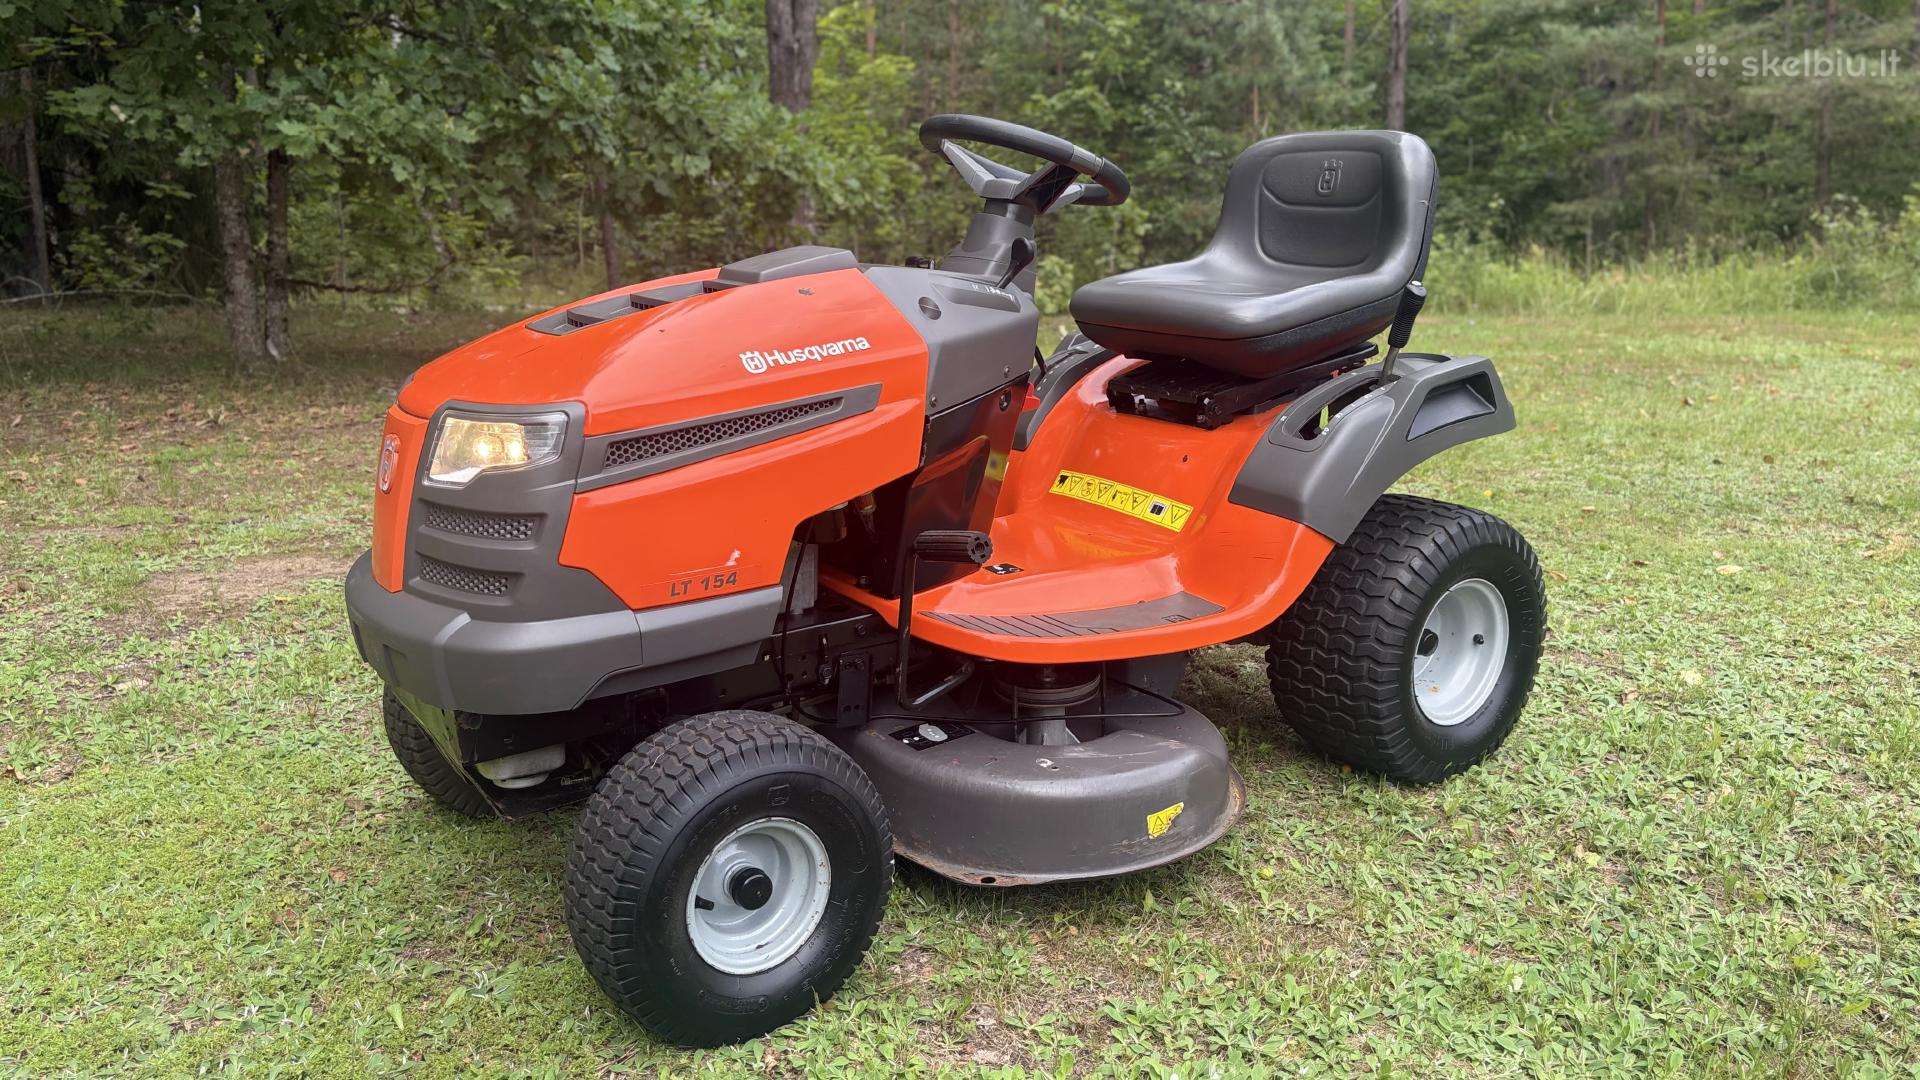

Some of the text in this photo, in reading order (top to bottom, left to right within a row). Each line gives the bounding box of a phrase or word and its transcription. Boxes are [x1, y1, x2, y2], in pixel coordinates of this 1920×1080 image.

[764, 336, 871, 367] Husqvarna
[670, 572, 737, 597] LT 154
